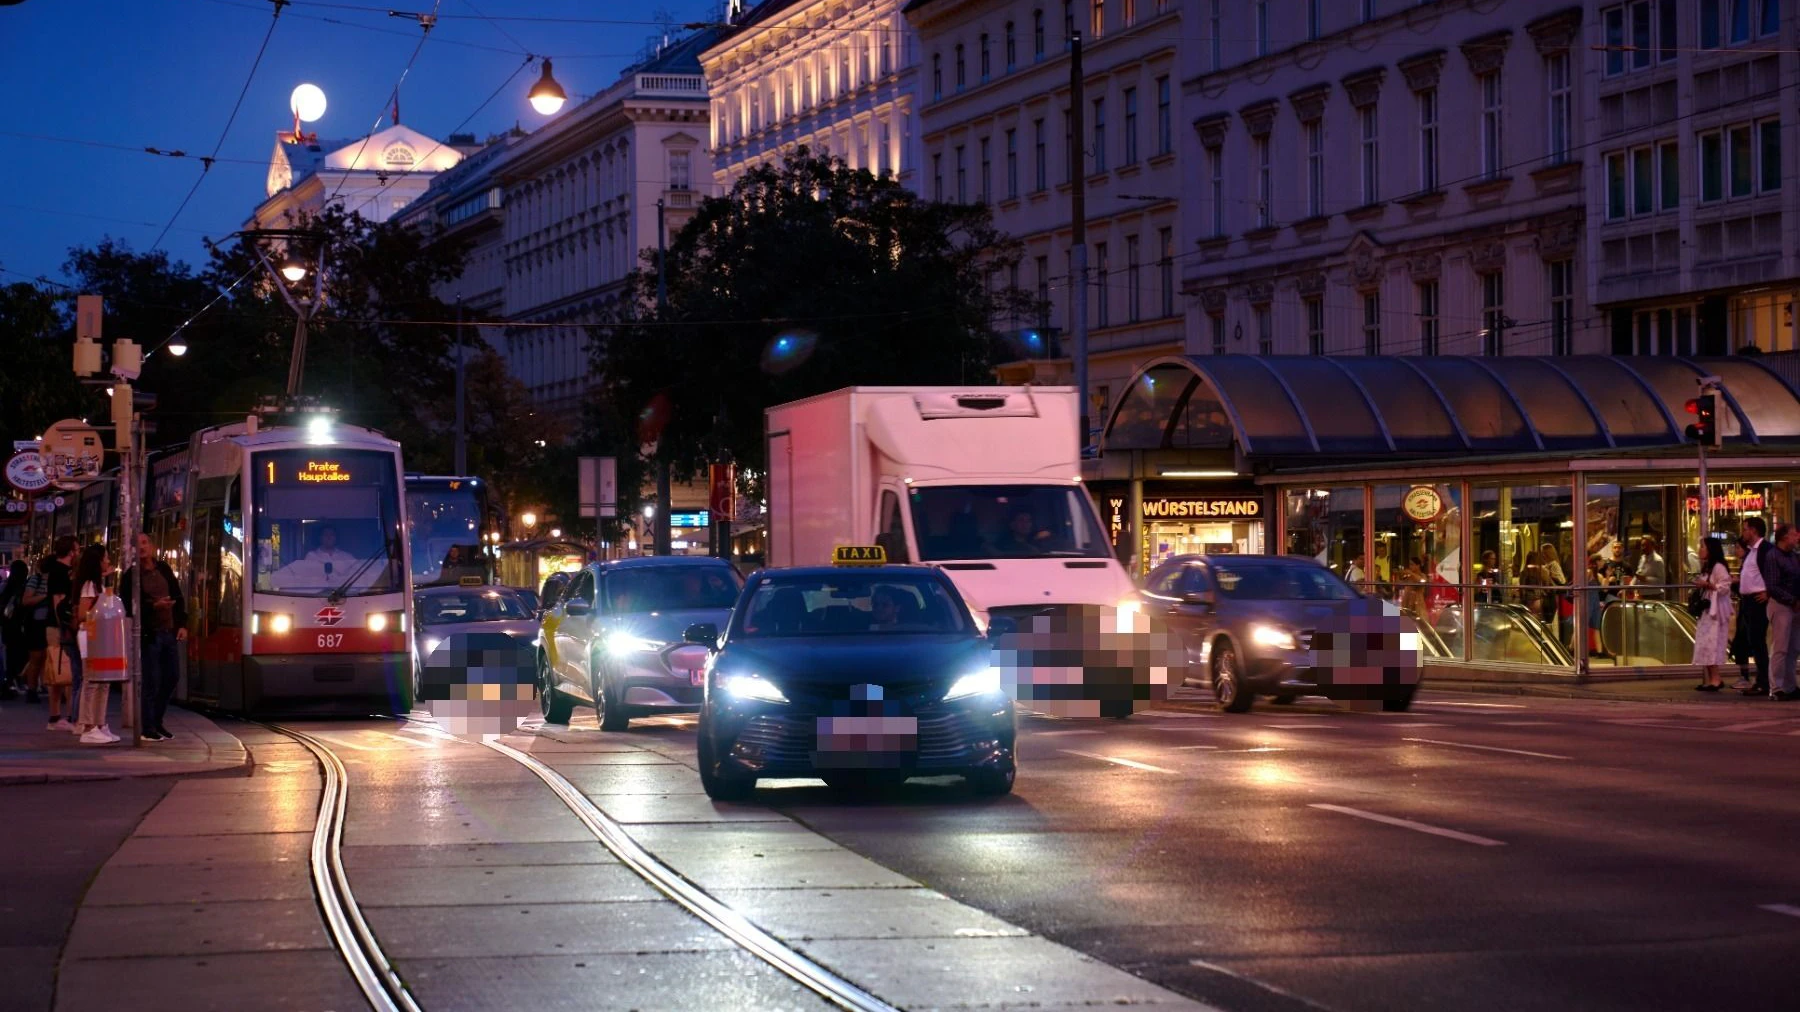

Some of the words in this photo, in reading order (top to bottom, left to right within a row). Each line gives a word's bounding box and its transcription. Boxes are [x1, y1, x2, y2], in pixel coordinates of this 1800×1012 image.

[308, 461, 340, 471] Prater
[267, 461, 275, 484] 1
[298, 471, 351, 483] Hauptallee
[12, 475, 49, 487] HALTESTELL
[1142, 498, 1259, 516] WÜRSTELSTAND
[840, 547, 879, 558] TAXI
[317, 633, 344, 648] 687
